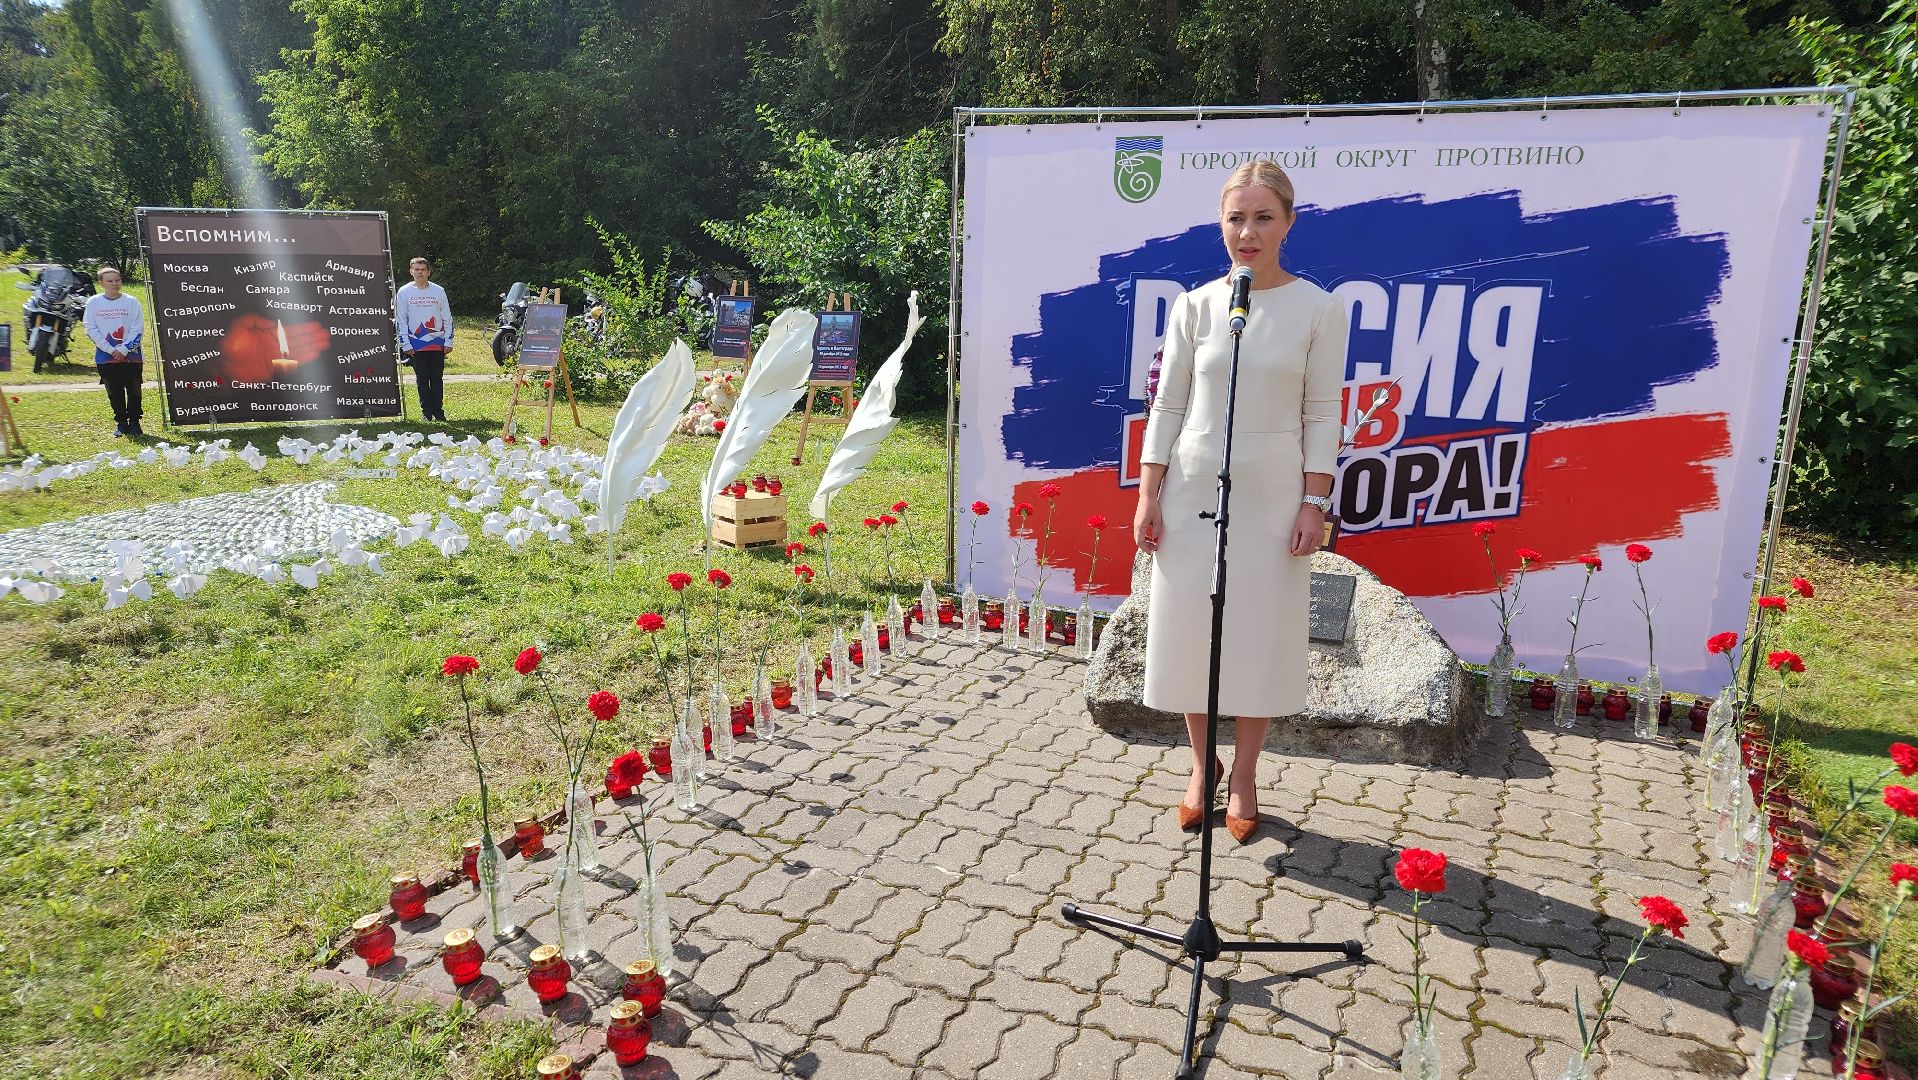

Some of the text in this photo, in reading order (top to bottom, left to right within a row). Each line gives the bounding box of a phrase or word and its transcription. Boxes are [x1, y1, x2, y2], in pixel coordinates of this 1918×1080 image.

[1335, 149, 1417, 168] ОКРУГ
[1435, 145, 1585, 167] ПРОТВИНО
[157, 226, 296, 243] Вспомним...
[163, 263, 208, 273] Москва
[233, 260, 276, 275] Кизляр
[325, 259, 375, 279] Армавир
[279, 272, 334, 282] Каспийск
[181, 283, 224, 294] Беслан
[246, 285, 290, 295] Самара
[317, 285, 365, 295] Грозный
[164, 302, 236, 318] Ставрополь
[266, 299, 324, 313] Хасавюрт
[329, 306, 387, 316] Астрахань
[167, 328, 225, 338] Гудермес
[330, 327, 380, 336] Воронеж
[337, 344, 387, 364] Буйнакск
[1129, 278, 1543, 423] РСИЯ
[172, 349, 220, 369] Назрань
[344, 375, 391, 383] Нальчик
[231, 380, 332, 393] Санкт-Петербург
[251, 402, 318, 411] Волгодонск
[337, 396, 396, 405] Махачкала
[176, 401, 239, 417] Буденовск
